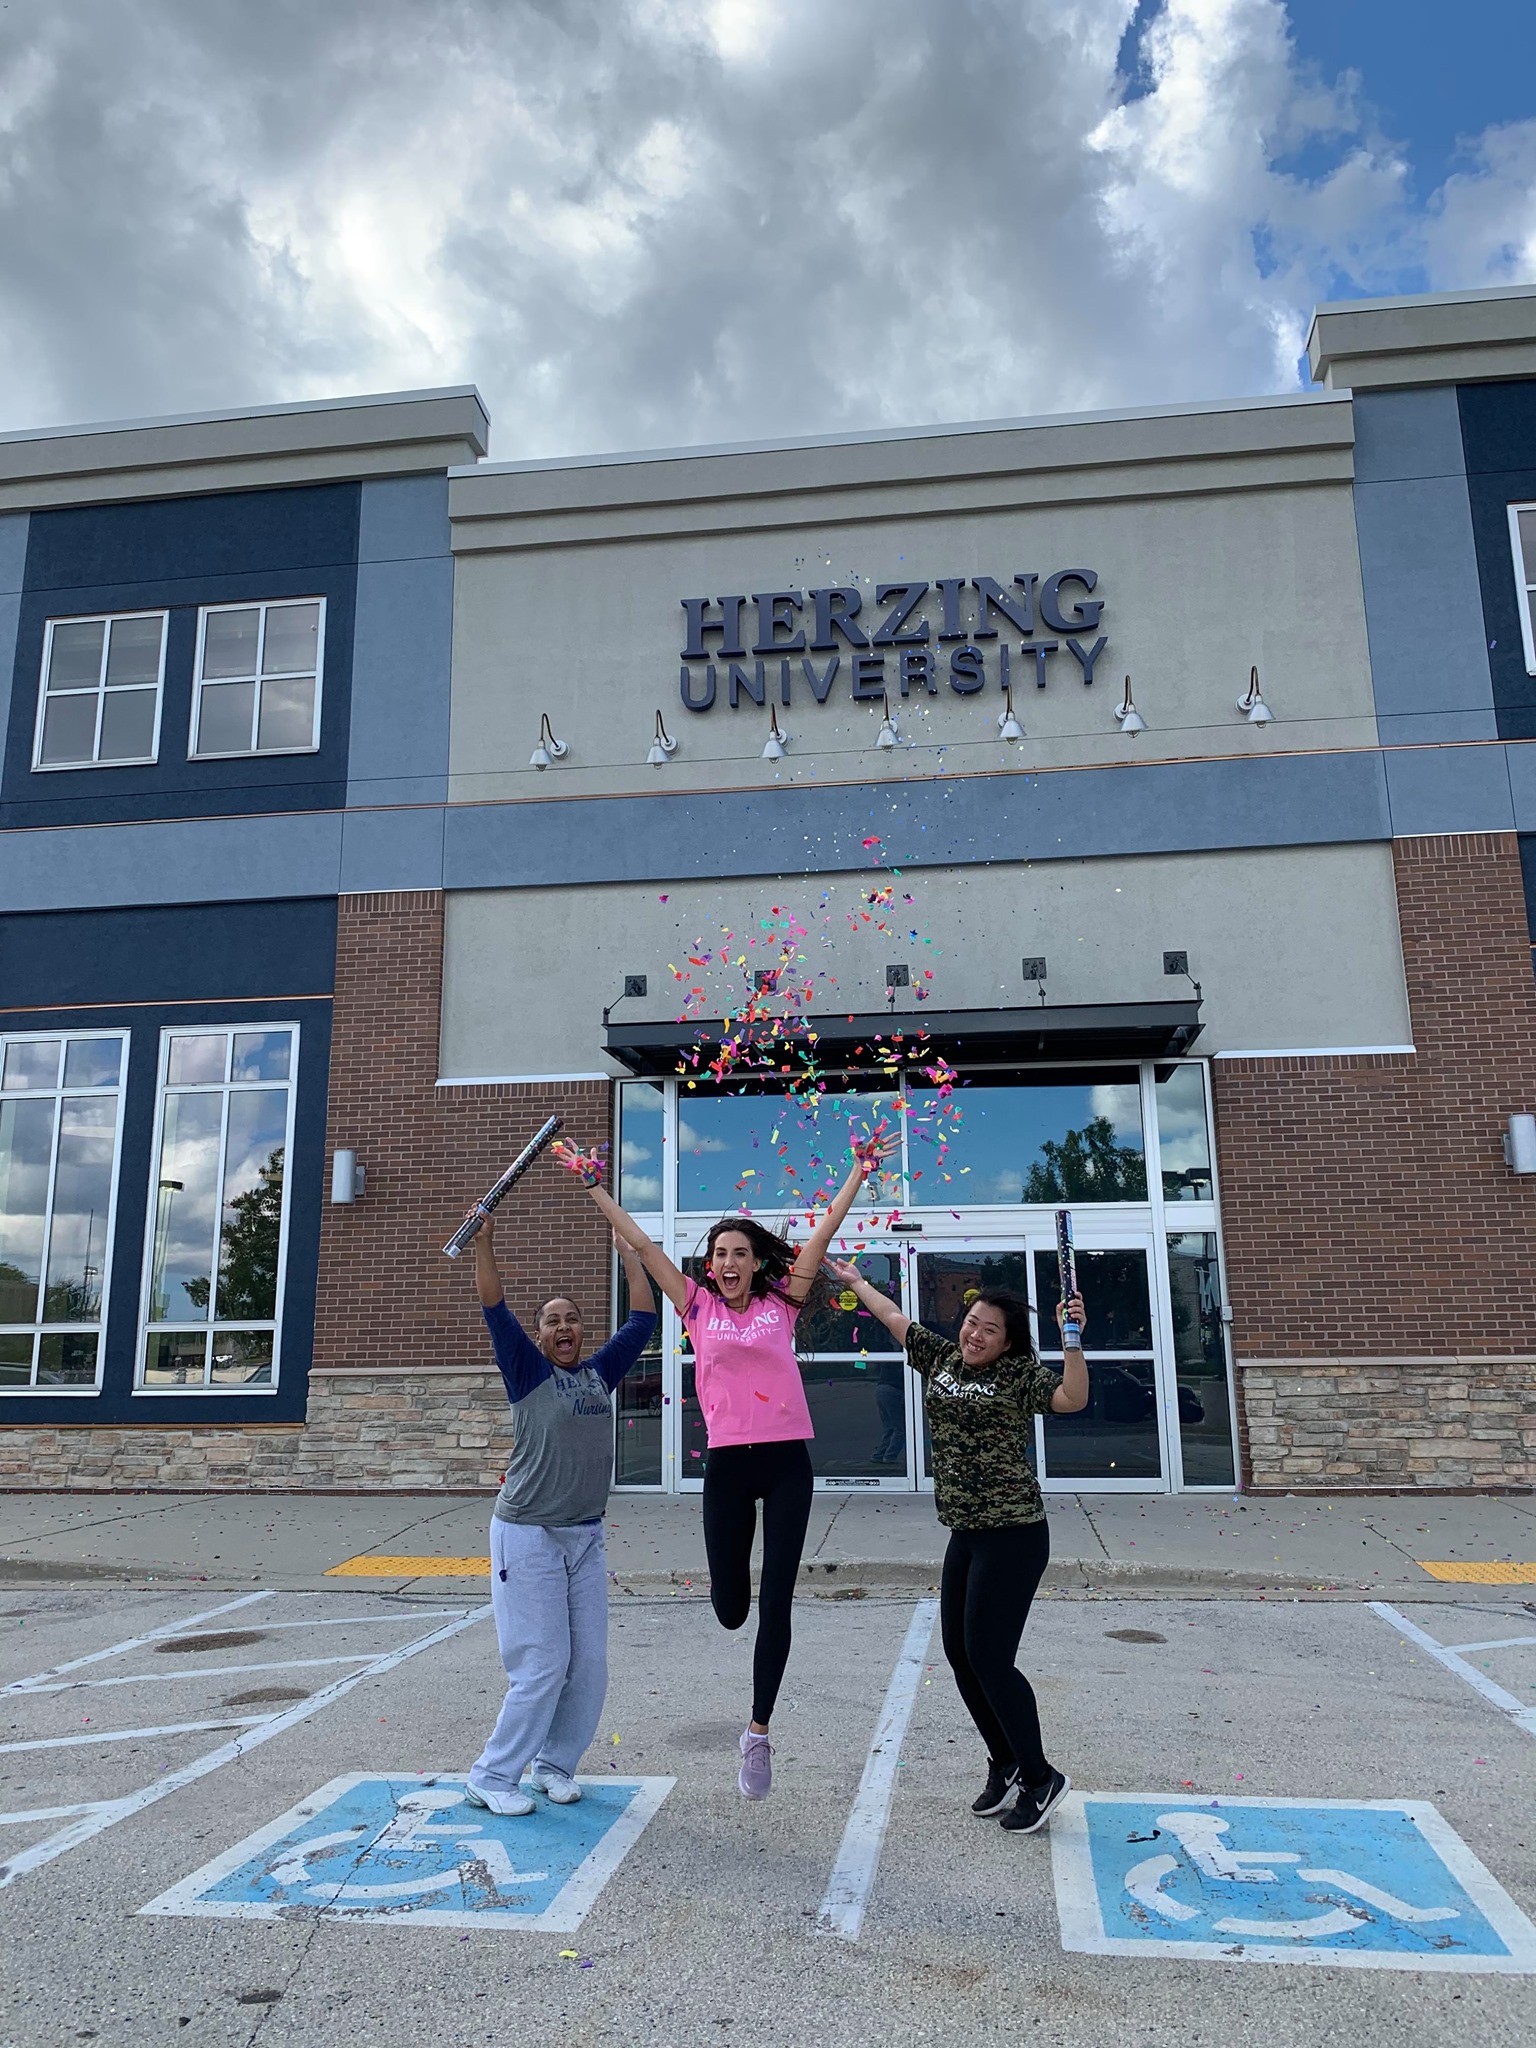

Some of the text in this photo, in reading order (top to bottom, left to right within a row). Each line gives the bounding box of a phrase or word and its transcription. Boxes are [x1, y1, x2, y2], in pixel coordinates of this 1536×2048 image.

[680, 568, 1105, 660] HERZING
[680, 636, 1108, 712] UNIVERSITY
[932, 1384, 981, 1401] UNISITY
[934, 1370, 996, 1396] ERING
[572, 1397, 612, 1419] Nursing
